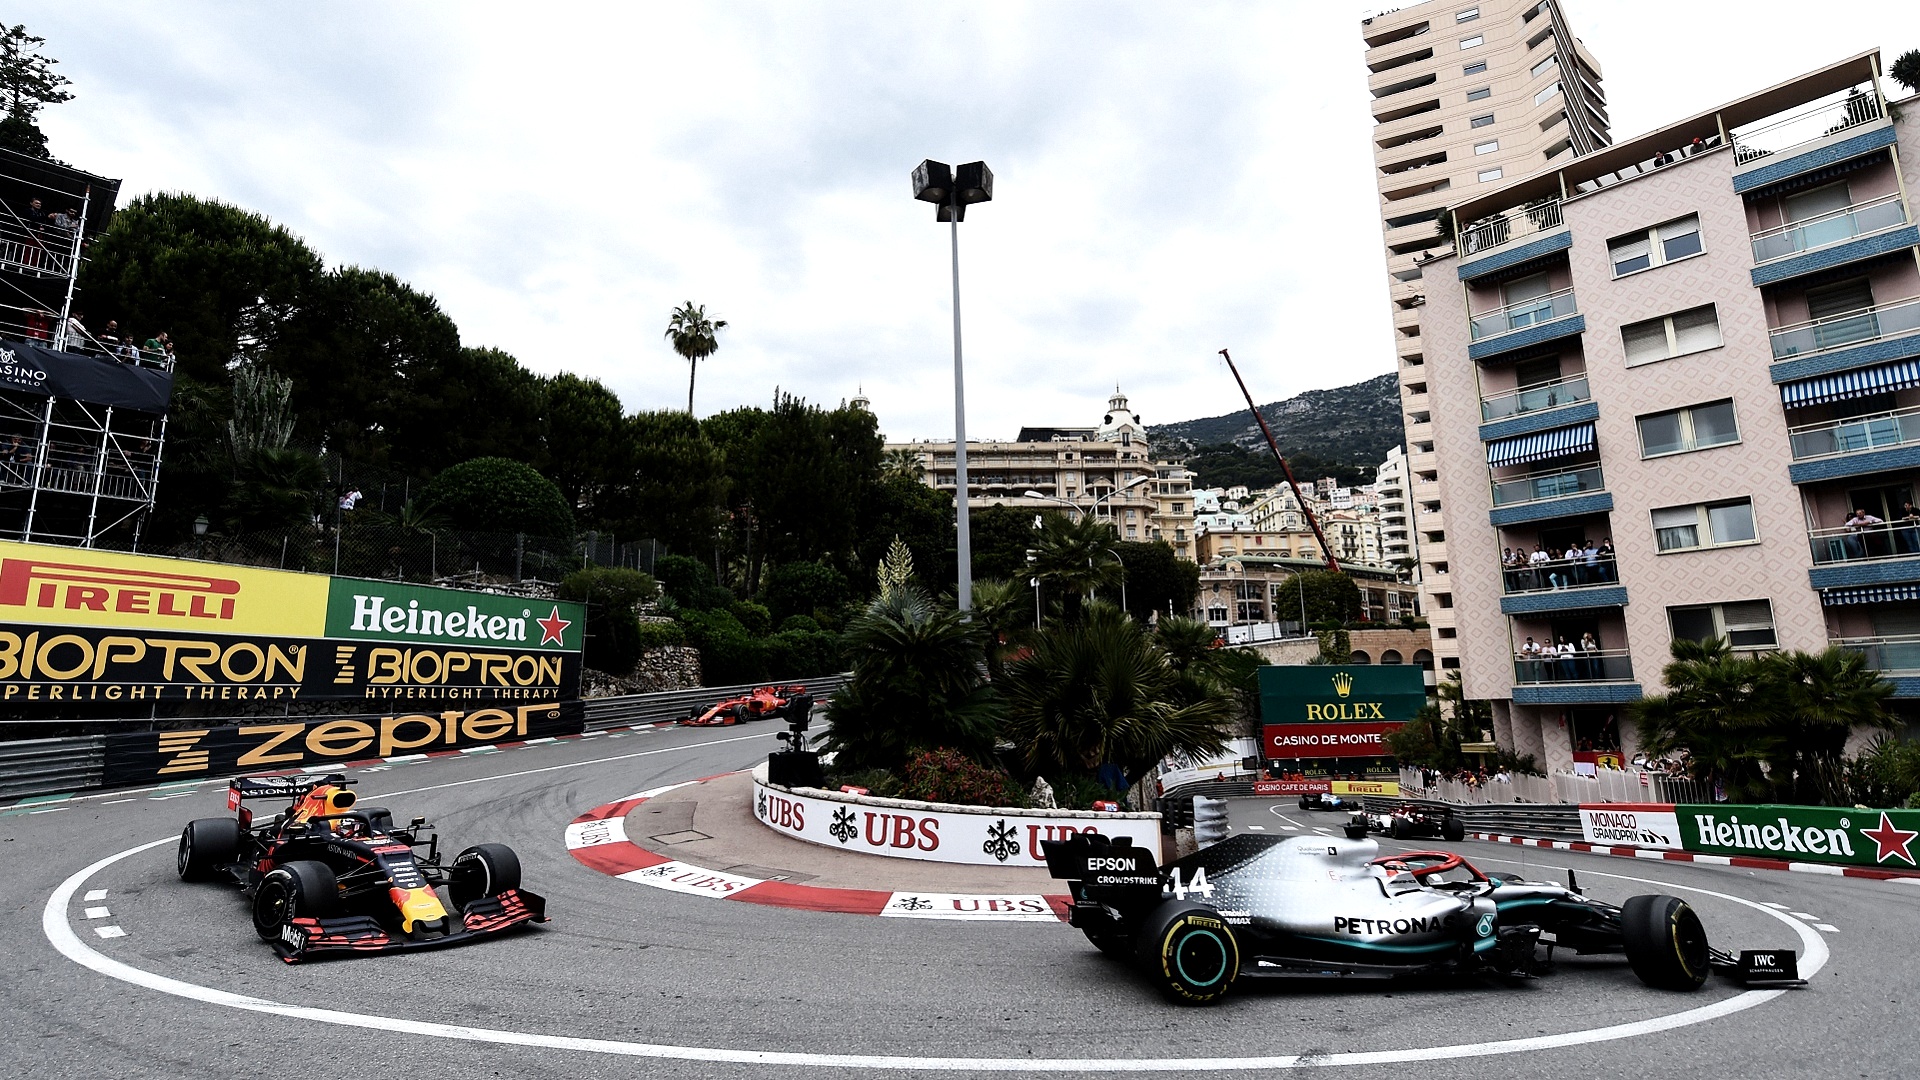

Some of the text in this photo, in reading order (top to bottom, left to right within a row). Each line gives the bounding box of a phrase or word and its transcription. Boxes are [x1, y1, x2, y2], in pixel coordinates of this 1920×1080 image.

[0, 558, 241, 620] PIRELLI
[350, 594, 527, 641] Heineken
[367, 647, 562, 686] BIOPTRON
[184, 685, 301, 700] THERAPY
[365, 687, 559, 699] HYPERLIGHT THERAPY
[1305, 702, 1385, 721] ROLEX
[236, 702, 561, 767] zepter
[1273, 735, 1319, 746] CASINO
[1321, 735, 1338, 745] DE
[1281, 783, 1300, 791] CAFE
[1299, 783, 1308, 791] DE
[1308, 783, 1329, 791] PARIS
[1347, 783, 1383, 793] PIRELLI
[767, 794, 805, 832] UBS
[1589, 812, 1637, 829] MONACO
[580, 827, 612, 845] UBS
[863, 811, 940, 852] UBS
[1592, 827, 1640, 842] GRANDPRIX
[1694, 814, 1855, 857] Heineken
[1087, 857, 1136, 871] EPSON
[671, 872, 745, 892] UBS
[1097, 875, 1158, 885] CROWDSTRIKE
[952, 898, 1044, 914] UBS
[1187, 915, 1221, 929] PIRELLI
[1334, 915, 1456, 935] PETRONAS
[1754, 954, 1776, 966] IWC
